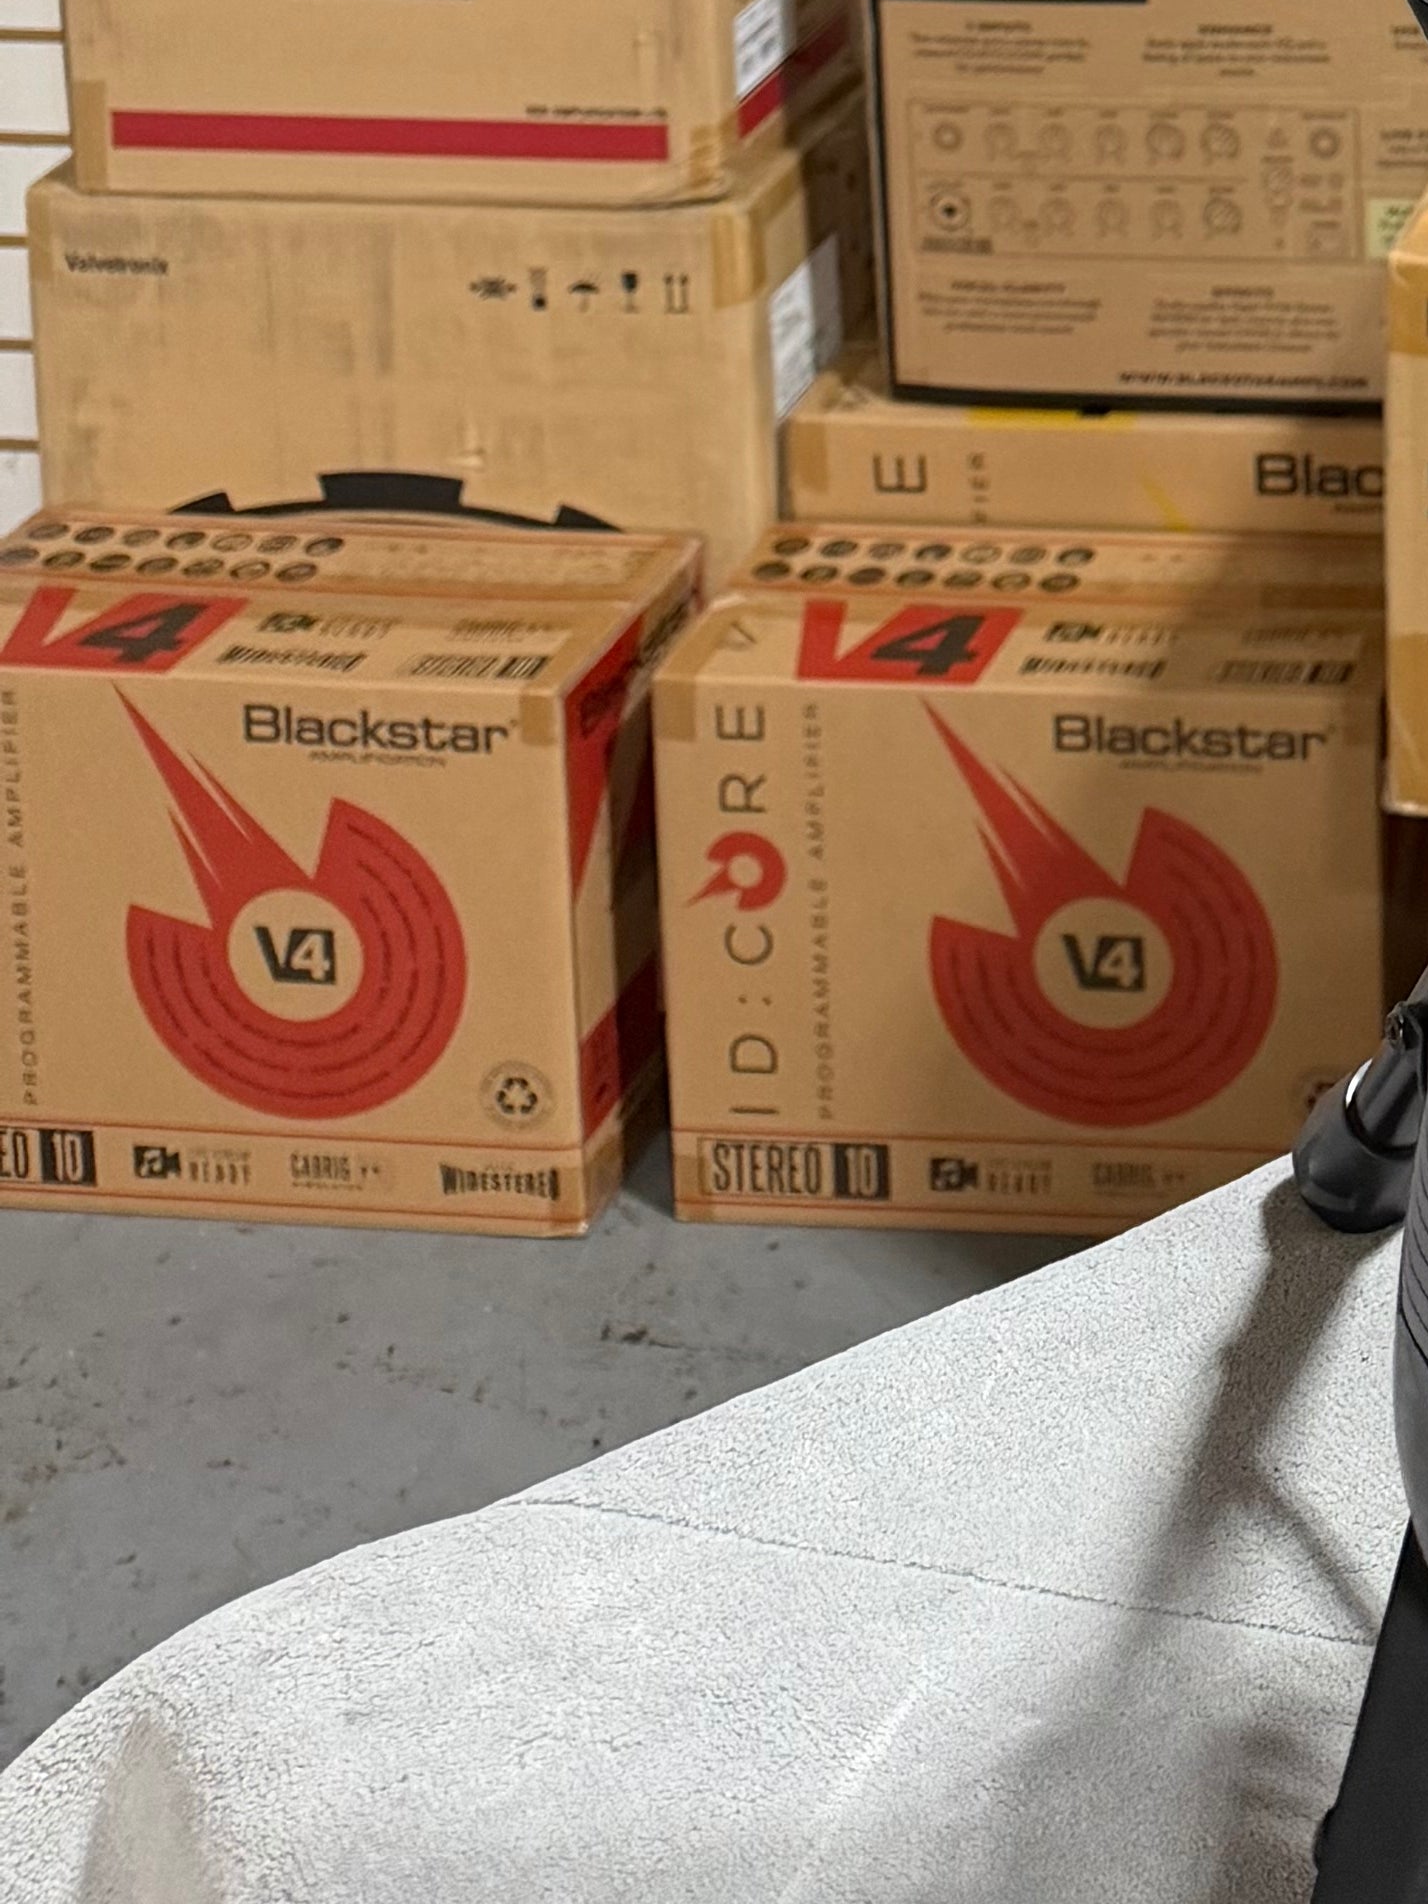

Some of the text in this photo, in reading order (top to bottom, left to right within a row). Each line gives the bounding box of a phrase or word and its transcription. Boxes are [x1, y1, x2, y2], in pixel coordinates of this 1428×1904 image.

[64, 252, 170, 276] Valvetronix
[795, 599, 1026, 686] V4
[242, 703, 510, 755] Blackstar
[1053, 714, 1327, 761] Blackstar
[2, 689, 26, 849] AMPLIFIER
[802, 701, 834, 1120] PROGRAMMABLE AMPLIFIER
[253, 924, 337, 987] V4
[1060, 933, 1146, 991] V4
[9, 865, 39, 1106] PROGRAMMABLE
[50, 1132, 86, 1184] 10
[712, 1141, 878, 1199] STEREO 10
